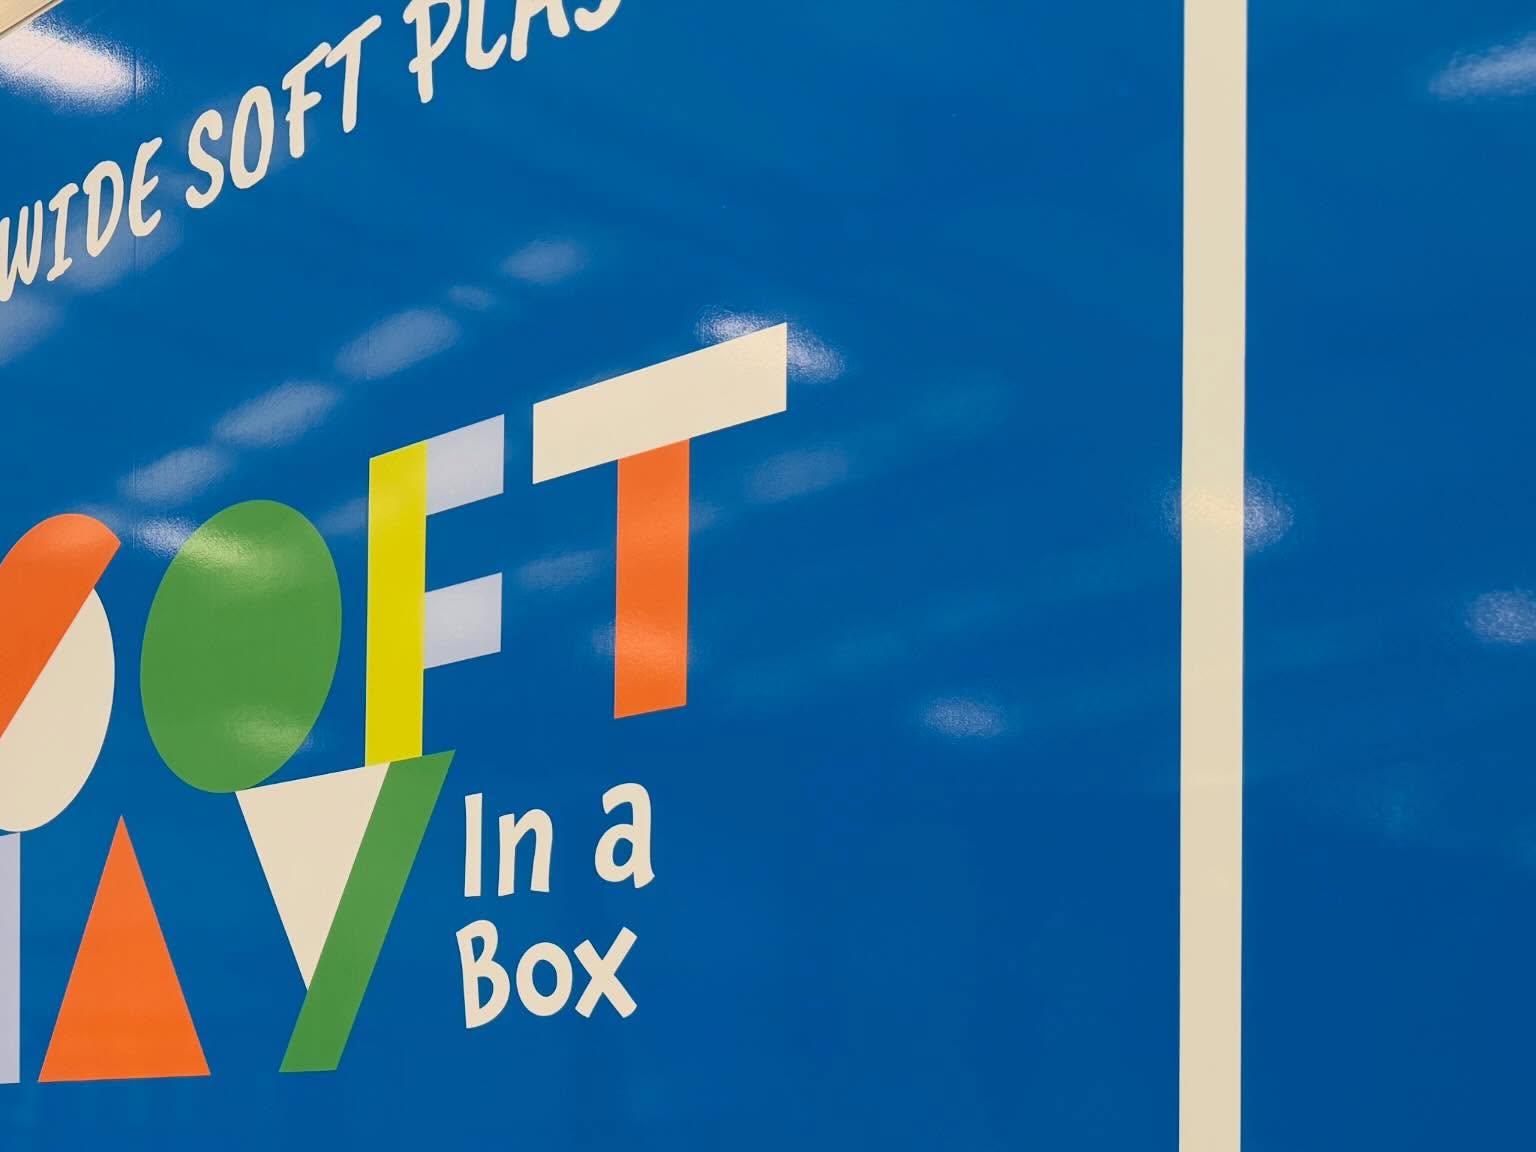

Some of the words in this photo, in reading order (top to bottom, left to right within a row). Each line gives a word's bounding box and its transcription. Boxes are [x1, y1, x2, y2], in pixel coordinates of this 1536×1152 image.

[184, 15, 383, 210] SOFT
[402, 0, 623, 104] PLA
[463, 792, 554, 899] In
[593, 782, 656, 890] a
[455, 918, 639, 1030] Box
